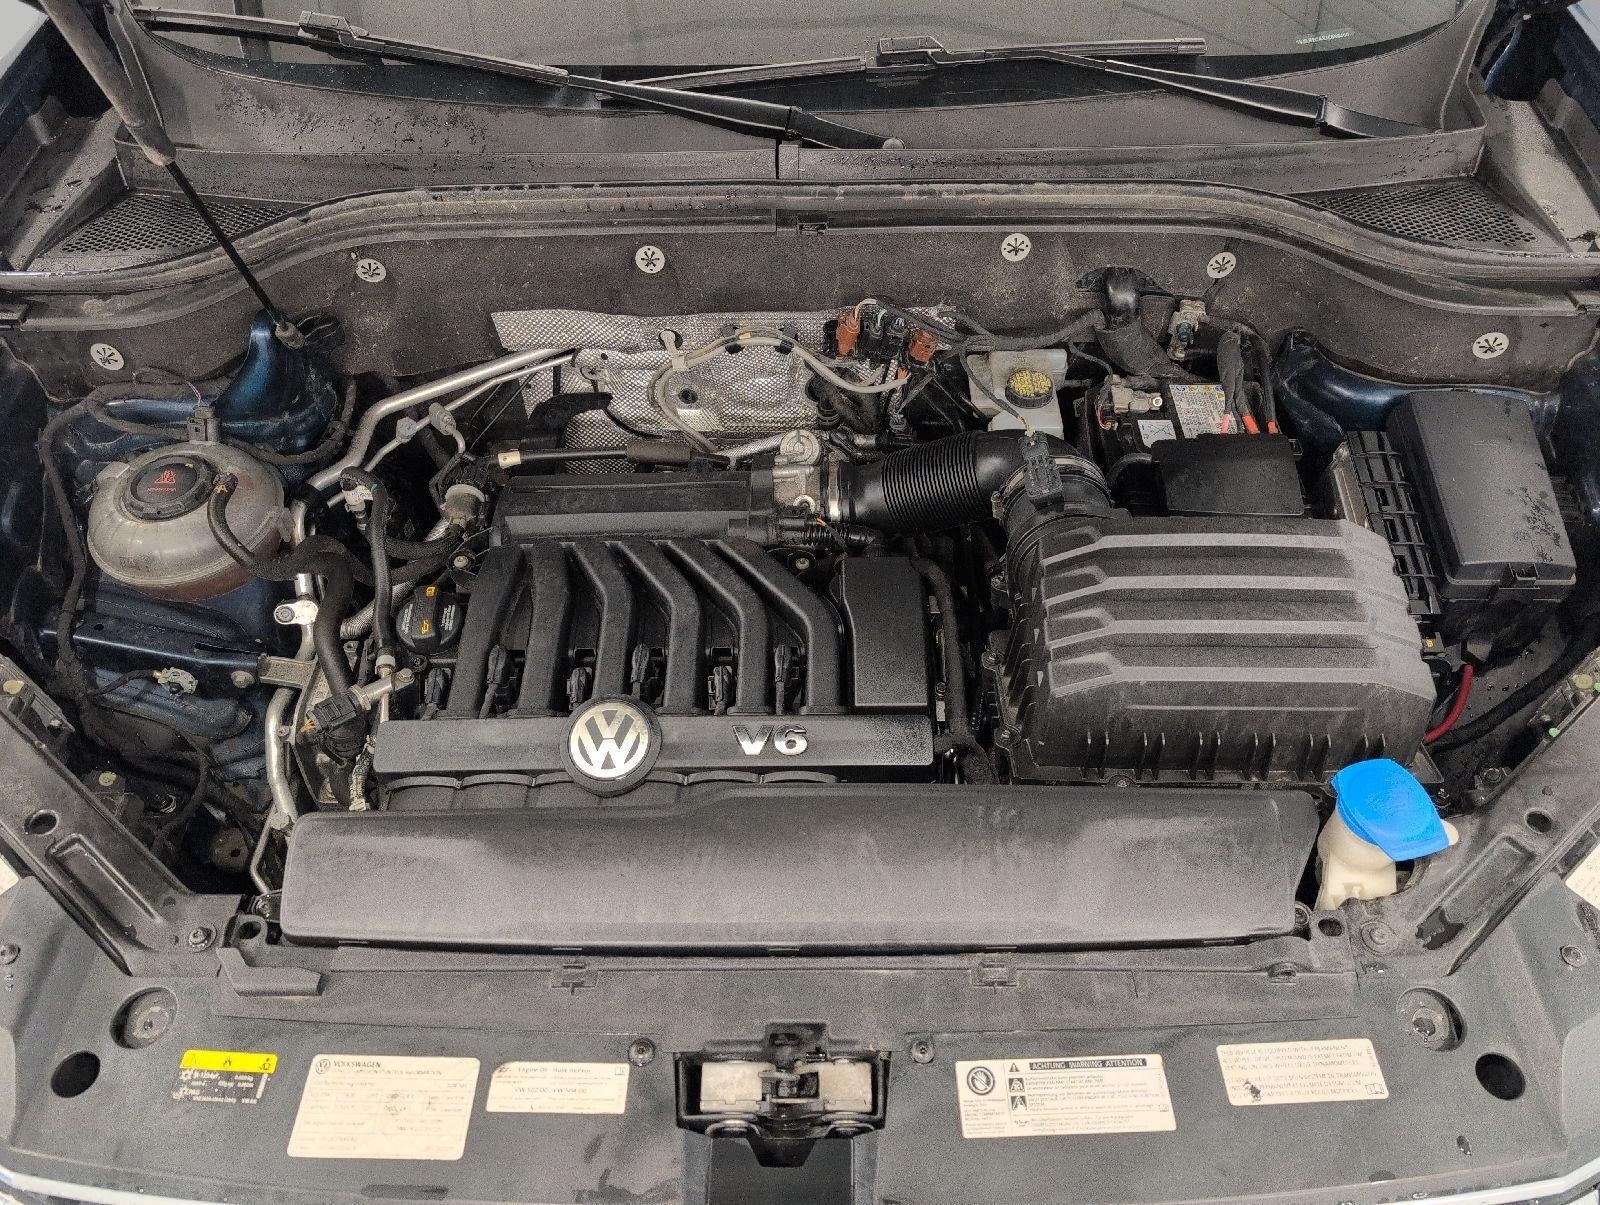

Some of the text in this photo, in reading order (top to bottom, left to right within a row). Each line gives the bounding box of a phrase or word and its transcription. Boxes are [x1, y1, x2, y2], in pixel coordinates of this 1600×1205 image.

[732, 724, 808, 755] V6
[333, 1060, 381, 1068] VOLKSWAGEN
[1032, 1058, 1143, 1070] ACHTUNG WARNING ATTENTION
